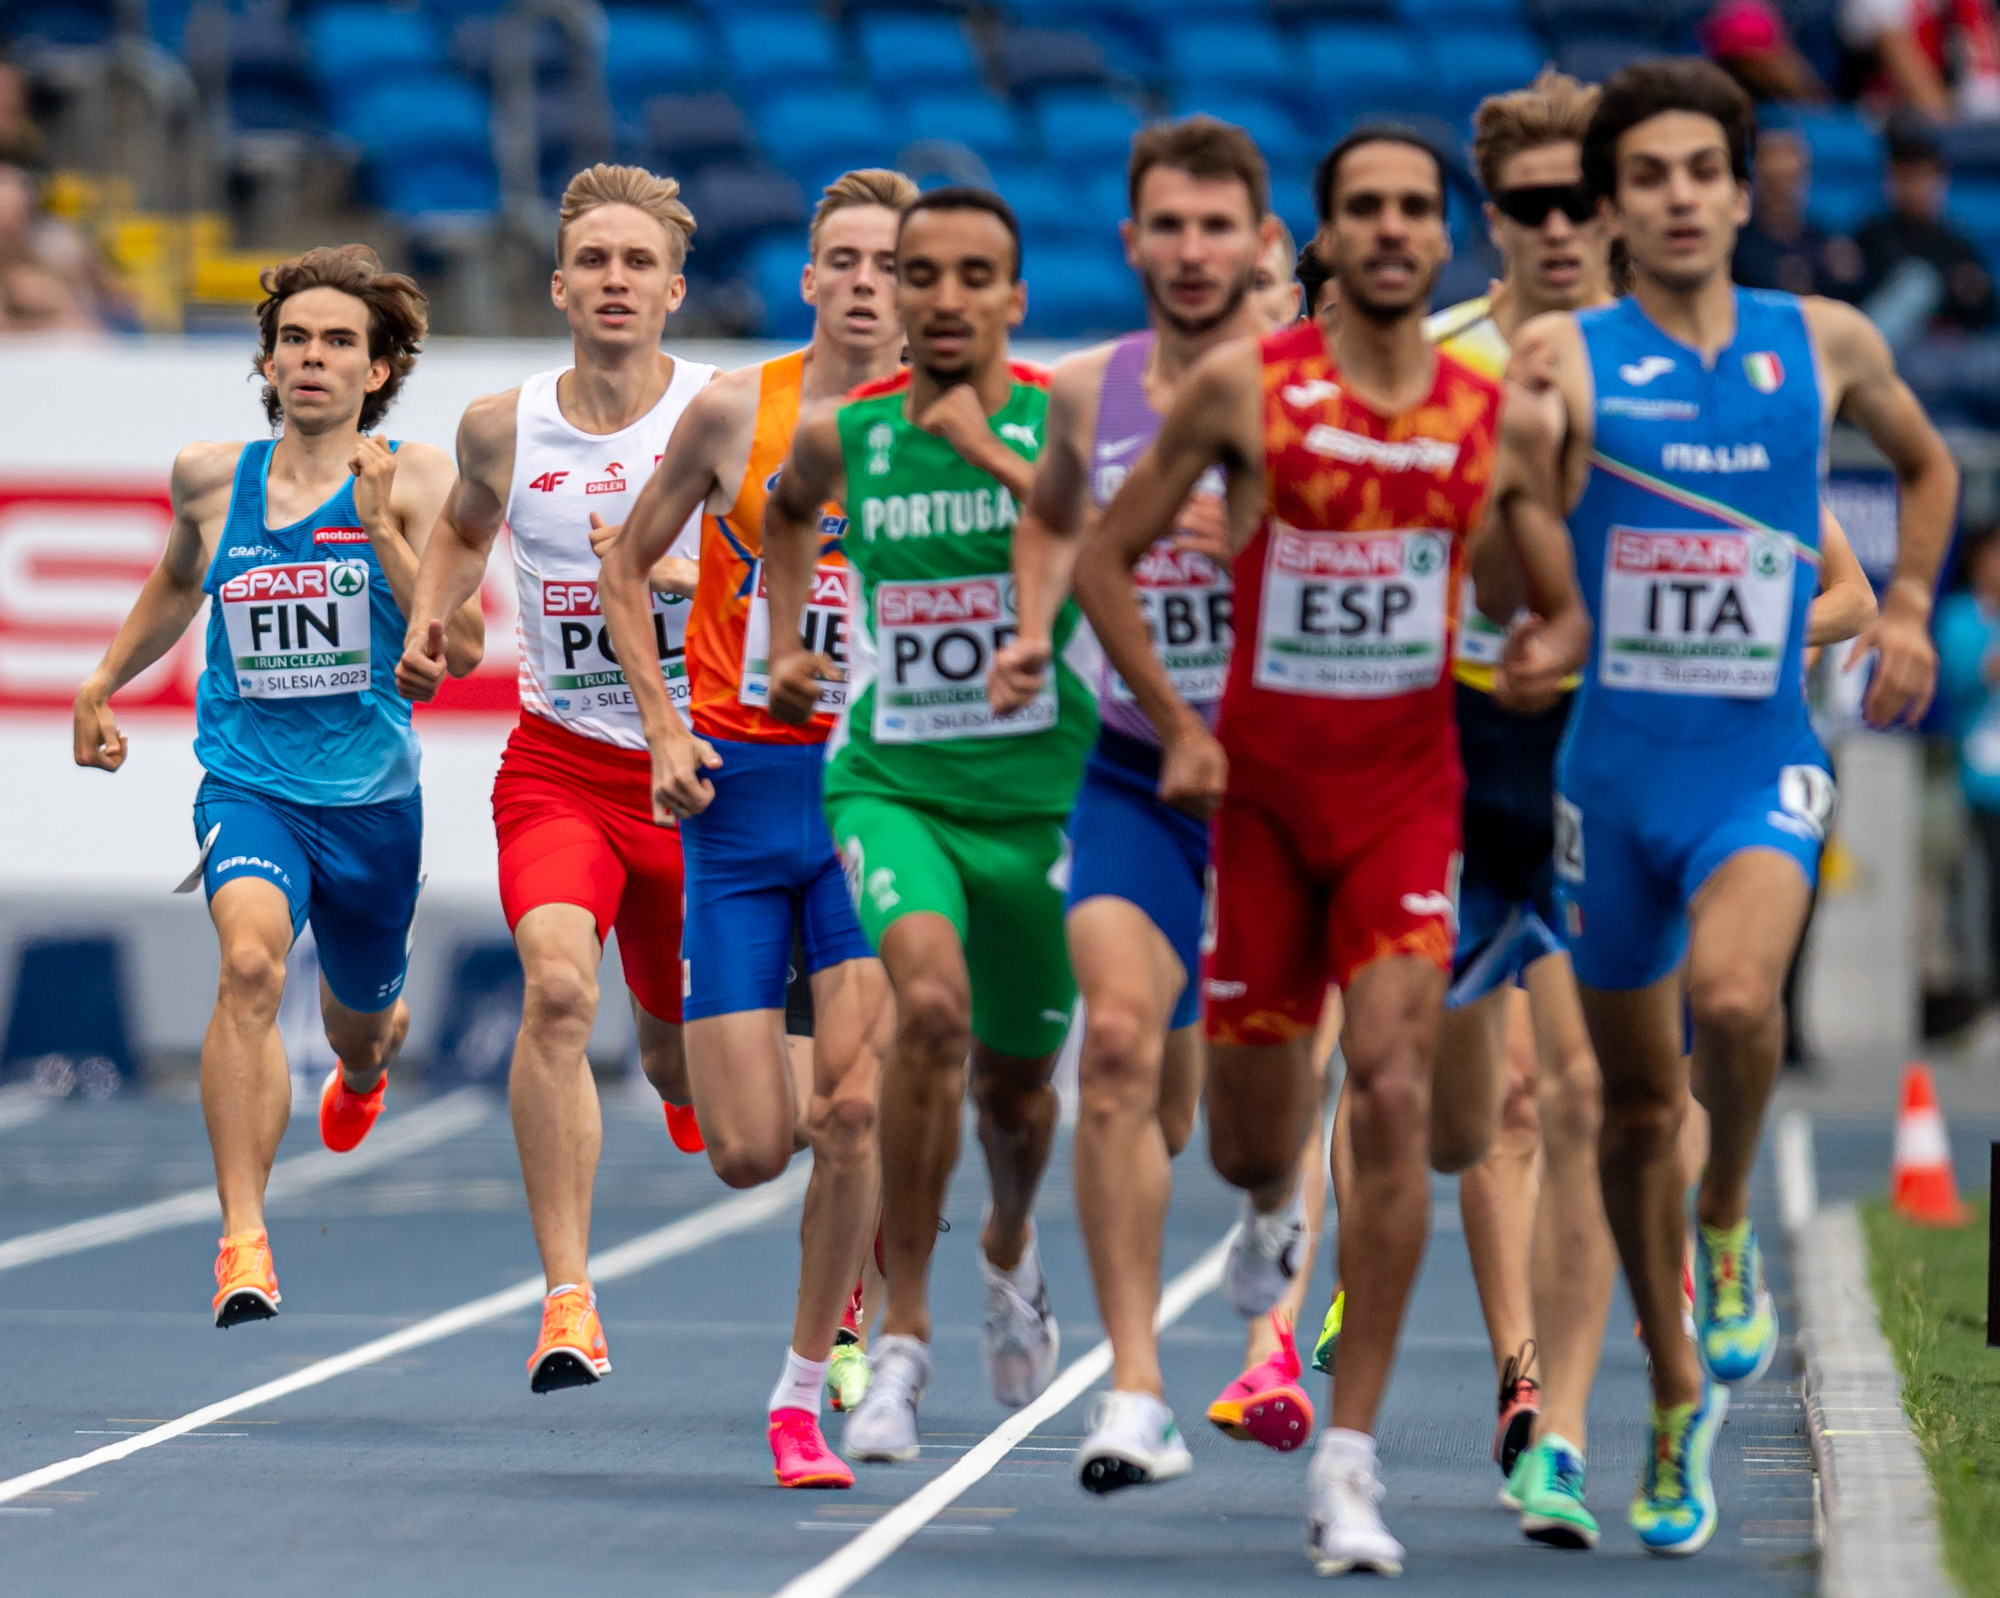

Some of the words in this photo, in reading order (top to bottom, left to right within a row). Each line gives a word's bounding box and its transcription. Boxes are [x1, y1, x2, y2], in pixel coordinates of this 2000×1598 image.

[1661, 443, 1771, 474] ITALIA
[529, 471, 570, 492] 4F
[588, 481, 624, 493] ORLEN
[861, 484, 1021, 543] PORTUGA
[228, 546, 272, 558] CRAFT
[225, 569, 324, 598] SPAR
[883, 584, 997, 621] SPAR
[1301, 584, 1414, 636] ESP
[1646, 580, 1754, 635] ITA
[250, 602, 340, 651] FIN
[260, 656, 288, 668] RUN
[268, 674, 326, 690] SILESIA
[330, 670, 367, 686] 2023
[585, 673, 617, 687] RUN
[598, 691, 636, 707] SILE
[216, 856, 282, 875] CRAFT
